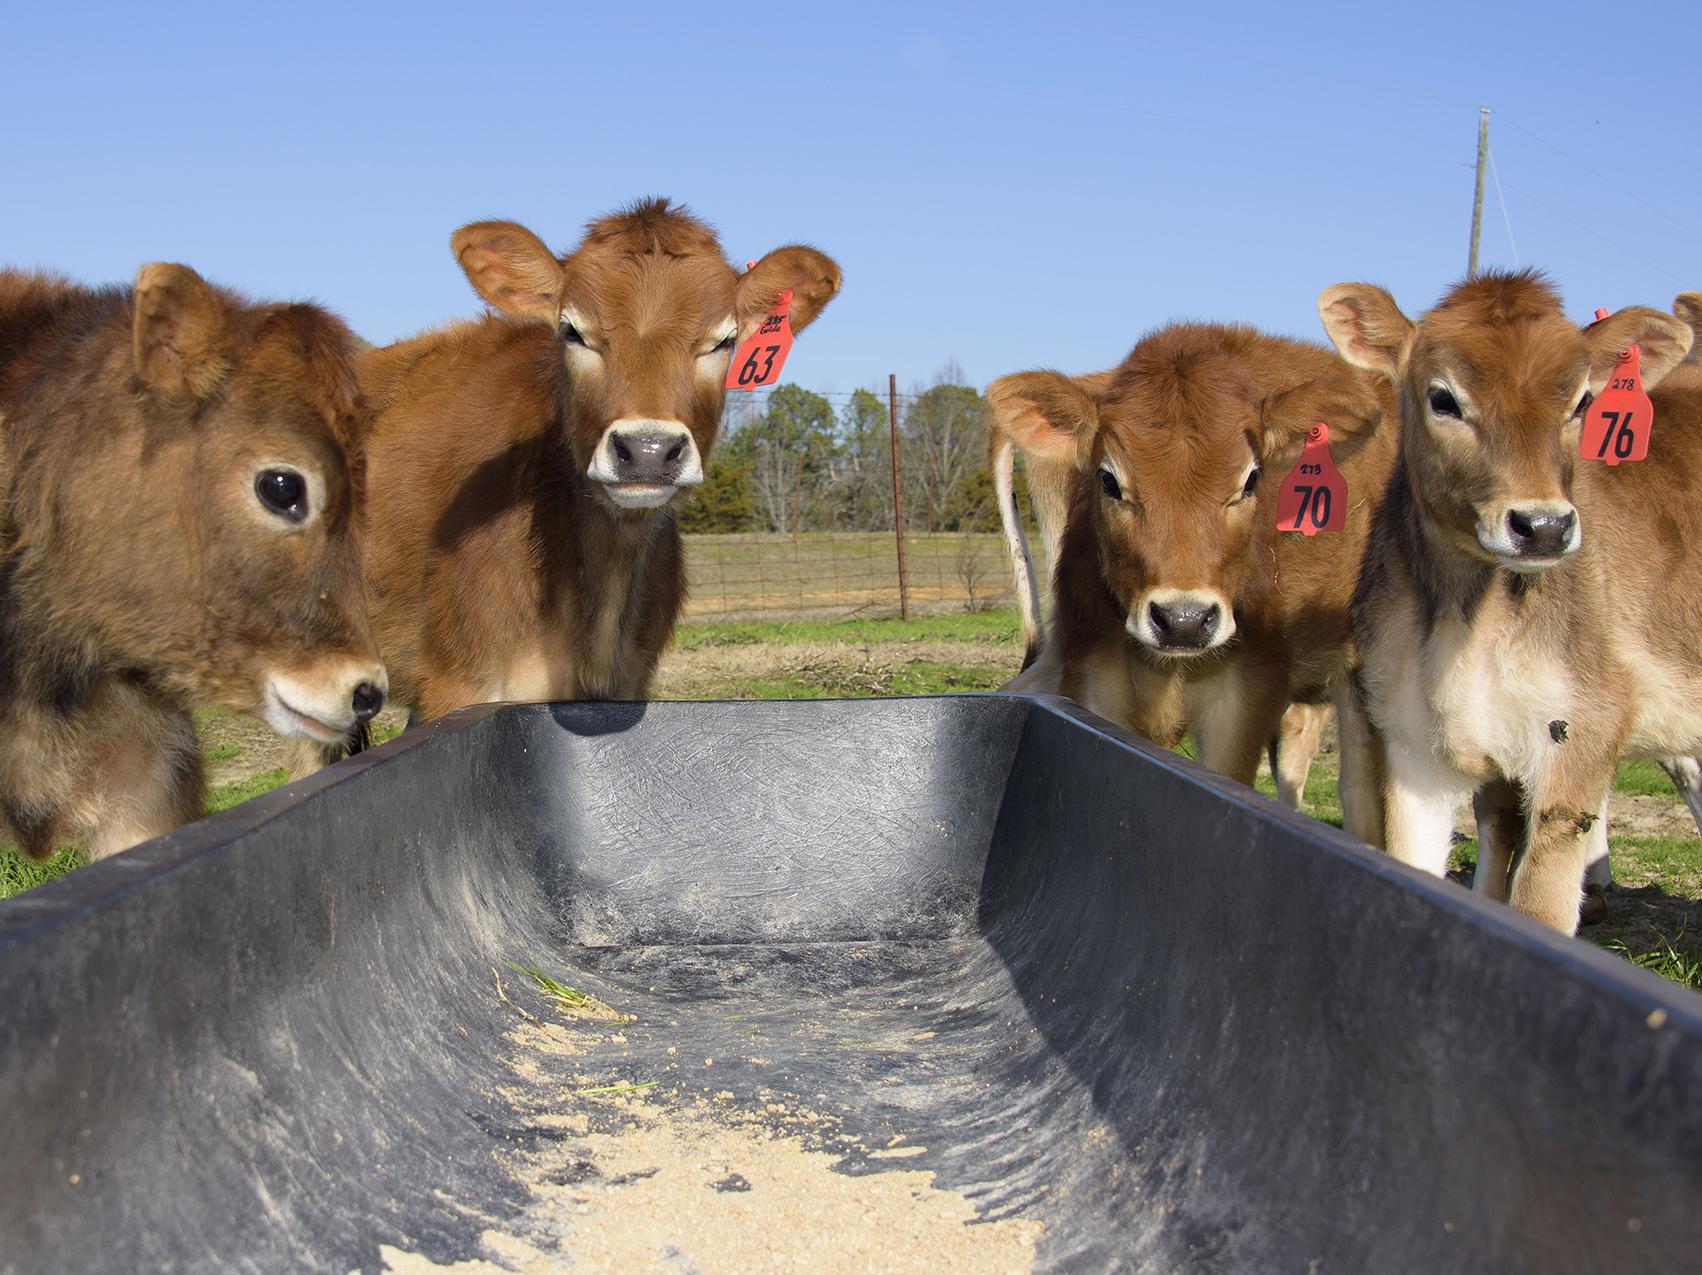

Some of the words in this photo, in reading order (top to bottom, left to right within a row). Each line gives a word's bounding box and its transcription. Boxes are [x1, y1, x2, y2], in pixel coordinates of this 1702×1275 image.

[738, 345, 781, 385] 63
[1612, 379, 1635, 391] 278
[1597, 411, 1634, 458] 76
[1300, 463, 1322, 475] 273
[1294, 485, 1332, 528] 70
